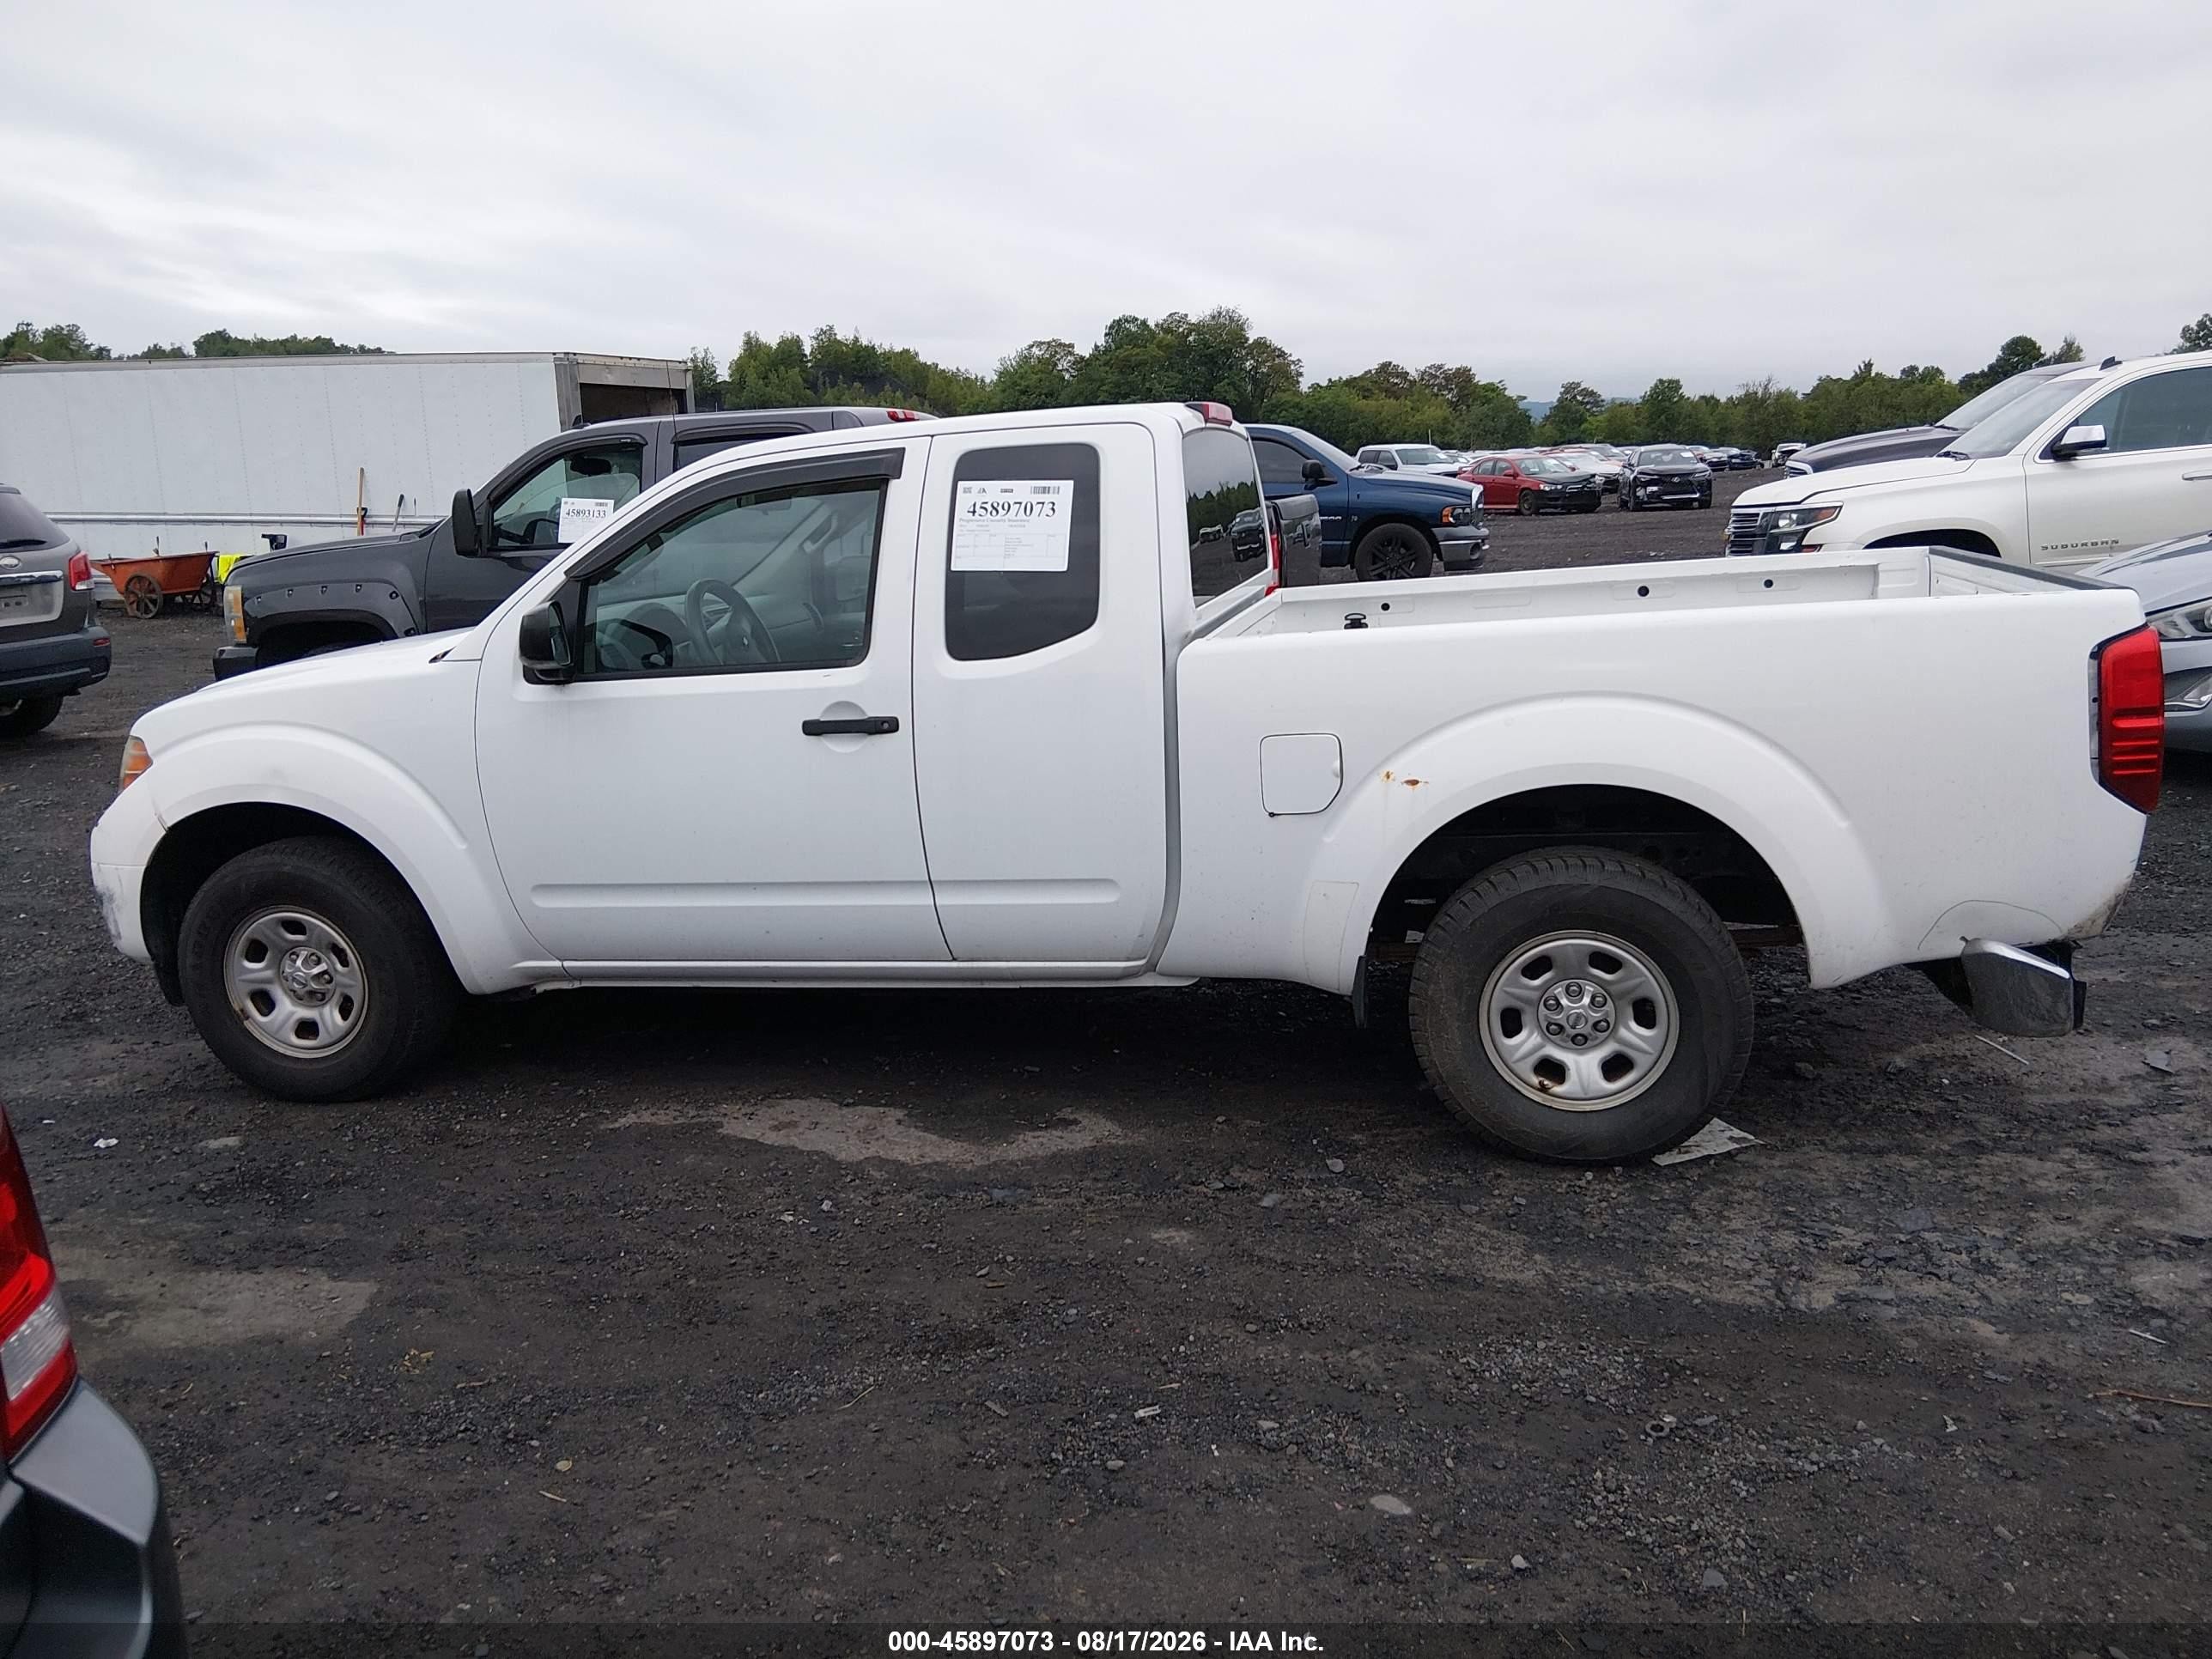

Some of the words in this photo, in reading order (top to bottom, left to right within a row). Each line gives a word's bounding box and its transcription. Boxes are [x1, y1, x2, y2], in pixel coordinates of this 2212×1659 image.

[566, 508, 606, 518] 45893133
[967, 501, 1056, 517] 45897073
[2040, 538, 2120, 550] SUBURBAN
